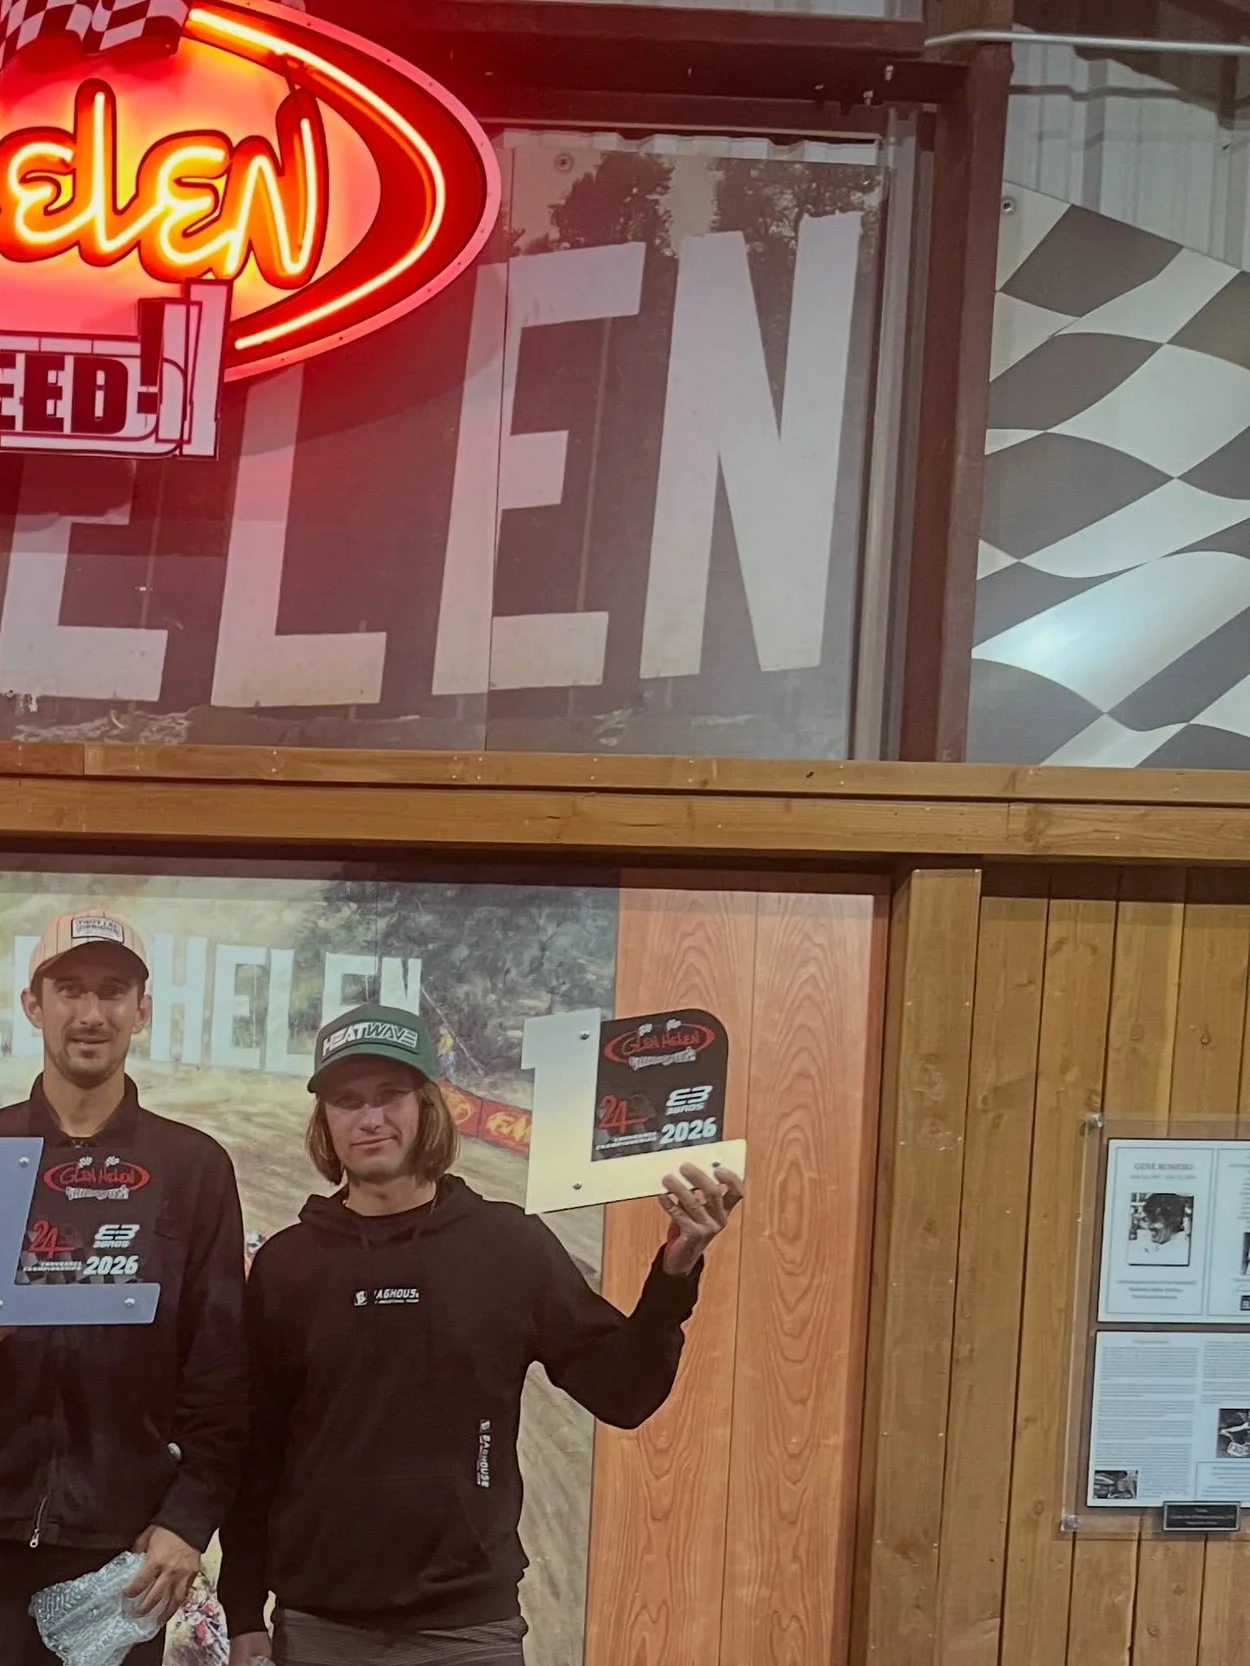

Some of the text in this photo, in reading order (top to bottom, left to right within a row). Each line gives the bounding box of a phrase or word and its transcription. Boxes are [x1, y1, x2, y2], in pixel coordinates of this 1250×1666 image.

[598, 1093, 648, 1136] 24
[659, 1117, 718, 1145] 2026
[28, 1220, 76, 1259] 24
[83, 1255, 139, 1276] 2026
